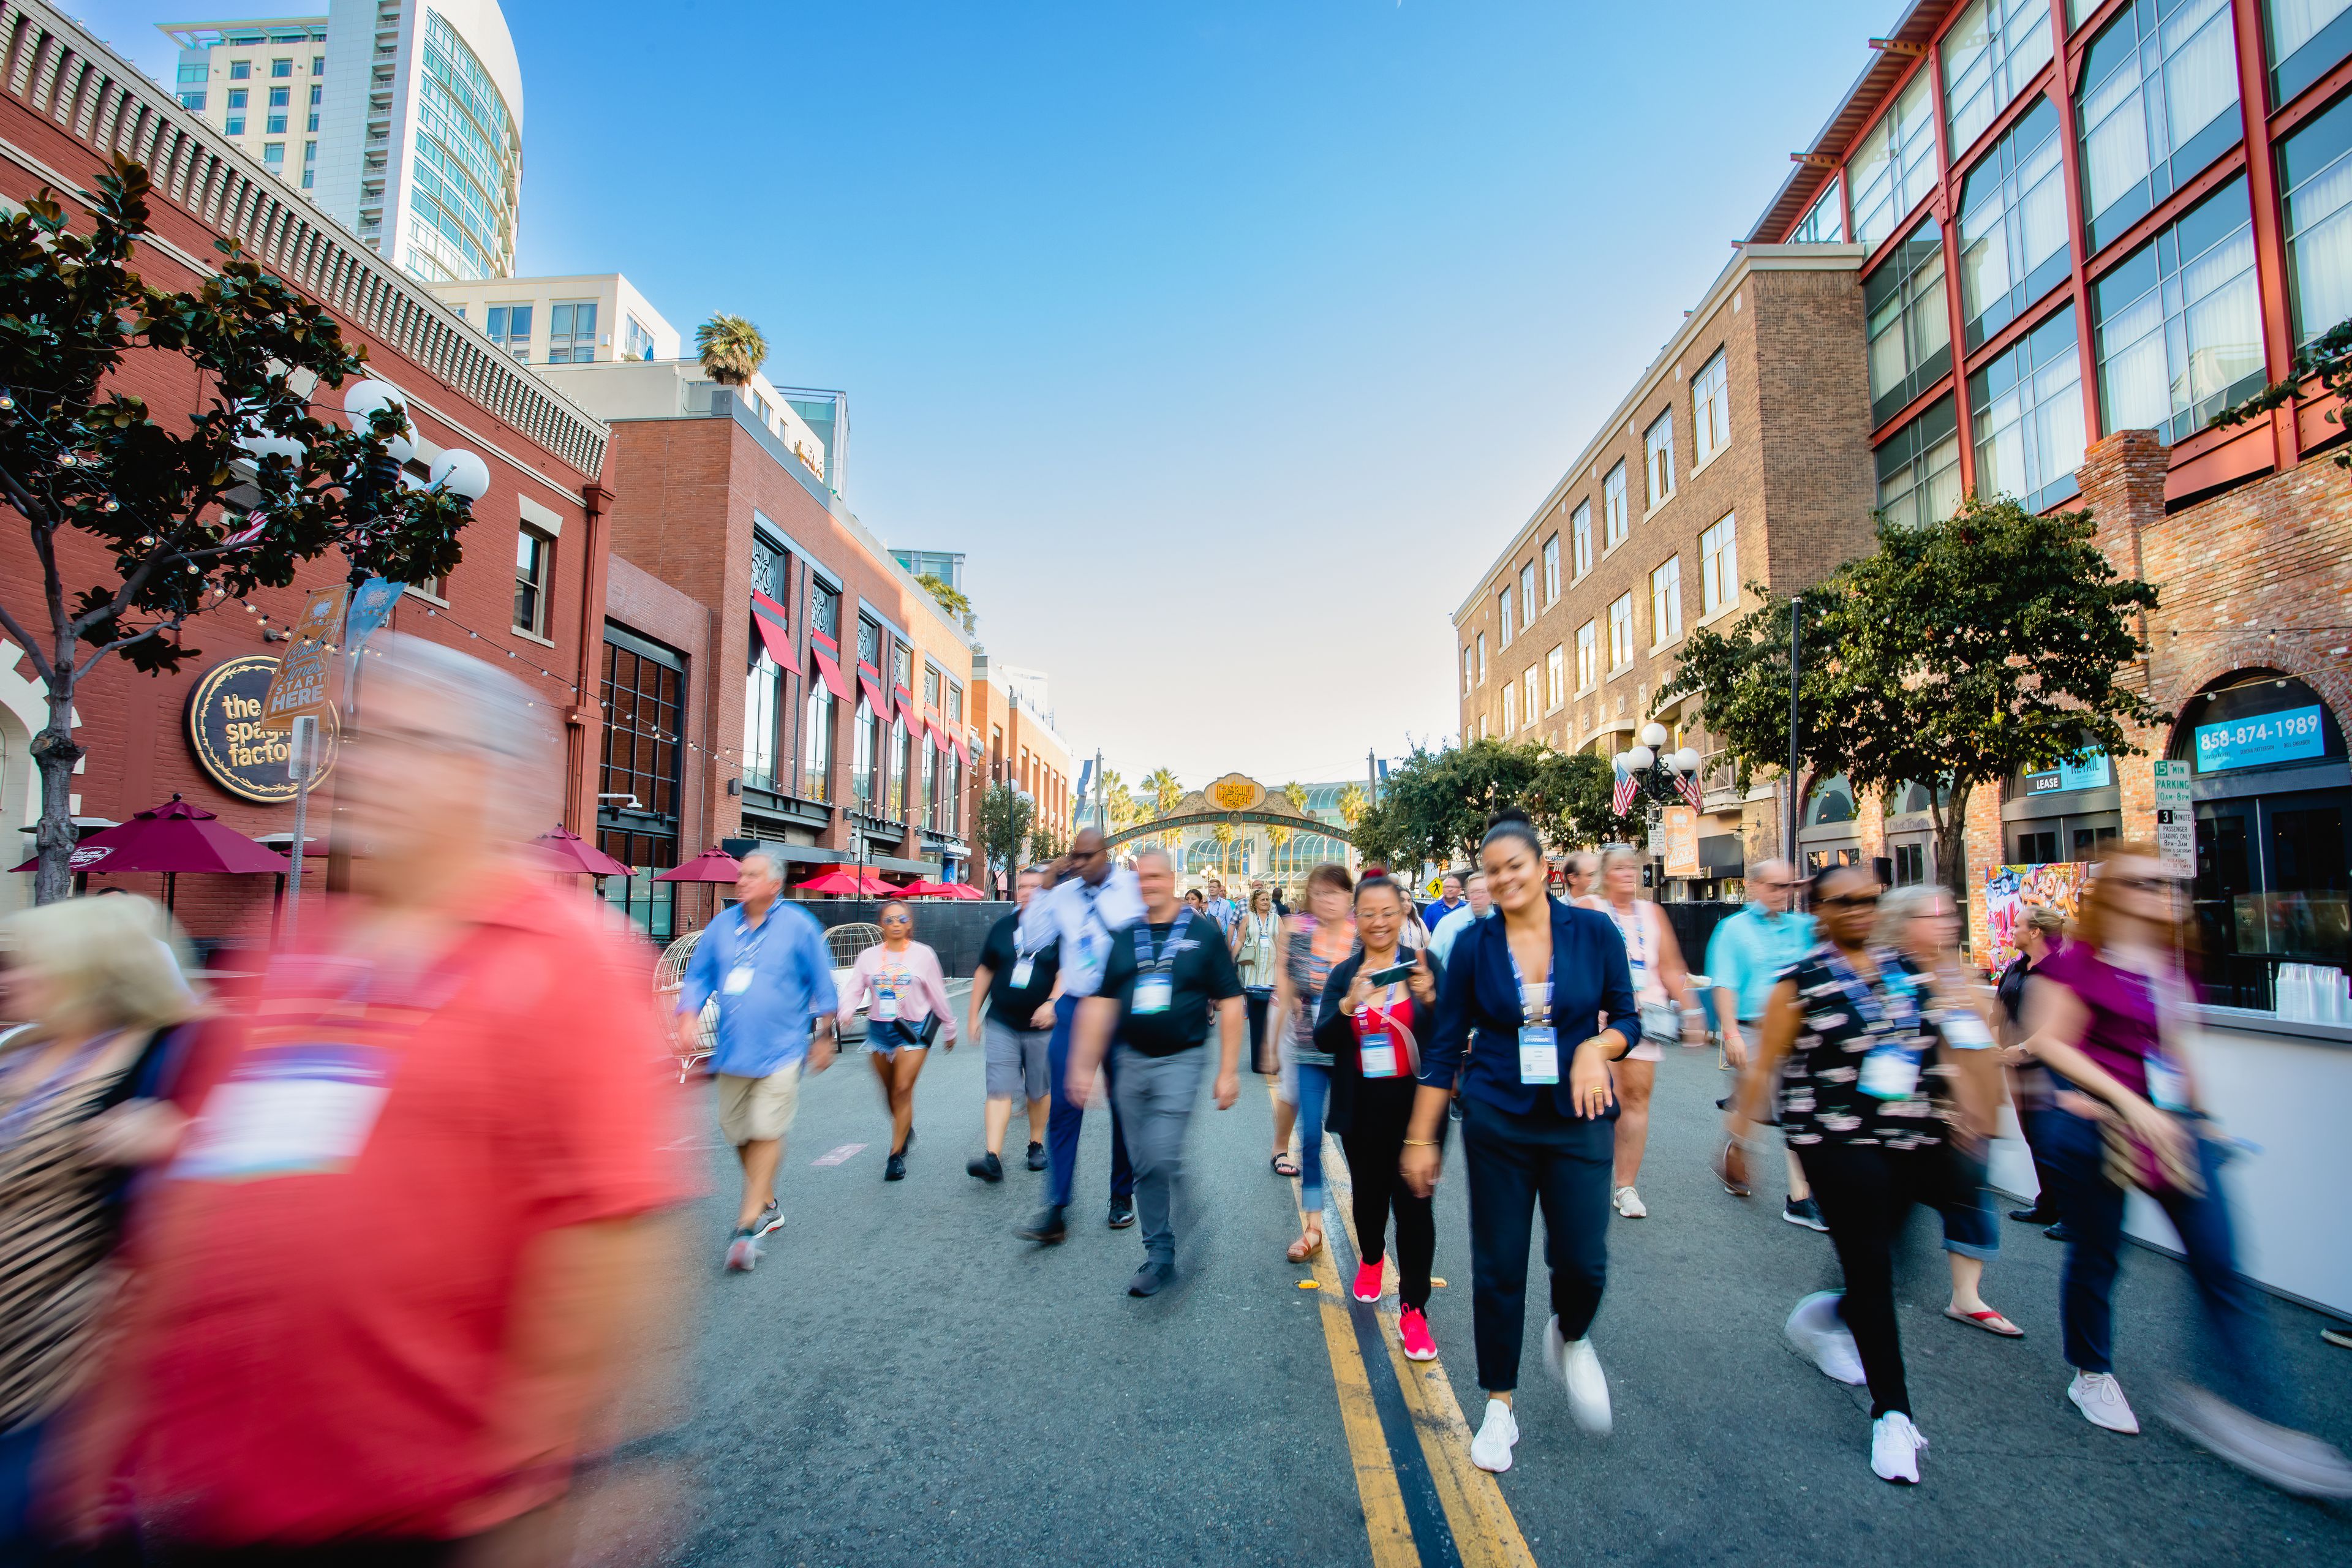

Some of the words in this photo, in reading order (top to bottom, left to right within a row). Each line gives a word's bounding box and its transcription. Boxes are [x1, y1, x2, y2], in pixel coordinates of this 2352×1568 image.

[287, 631, 330, 662] Good
[284, 656, 323, 682] Times
[275, 673, 325, 695] START
[222, 694, 261, 719] the
[271, 684, 324, 713] HERE
[2201, 715, 2318, 750] 858-874-1989
[2155, 763, 2167, 774] 15
[1216, 781, 1254, 801] Gaslamp
[2036, 777, 2058, 790] LEASE
[2156, 780, 2189, 790] PARKING
[1115, 820, 1173, 842] HISTORIC
[1180, 814, 1218, 824] HEART
[1279, 817, 1303, 827] SAN
[2163, 811, 2168, 823] 3
